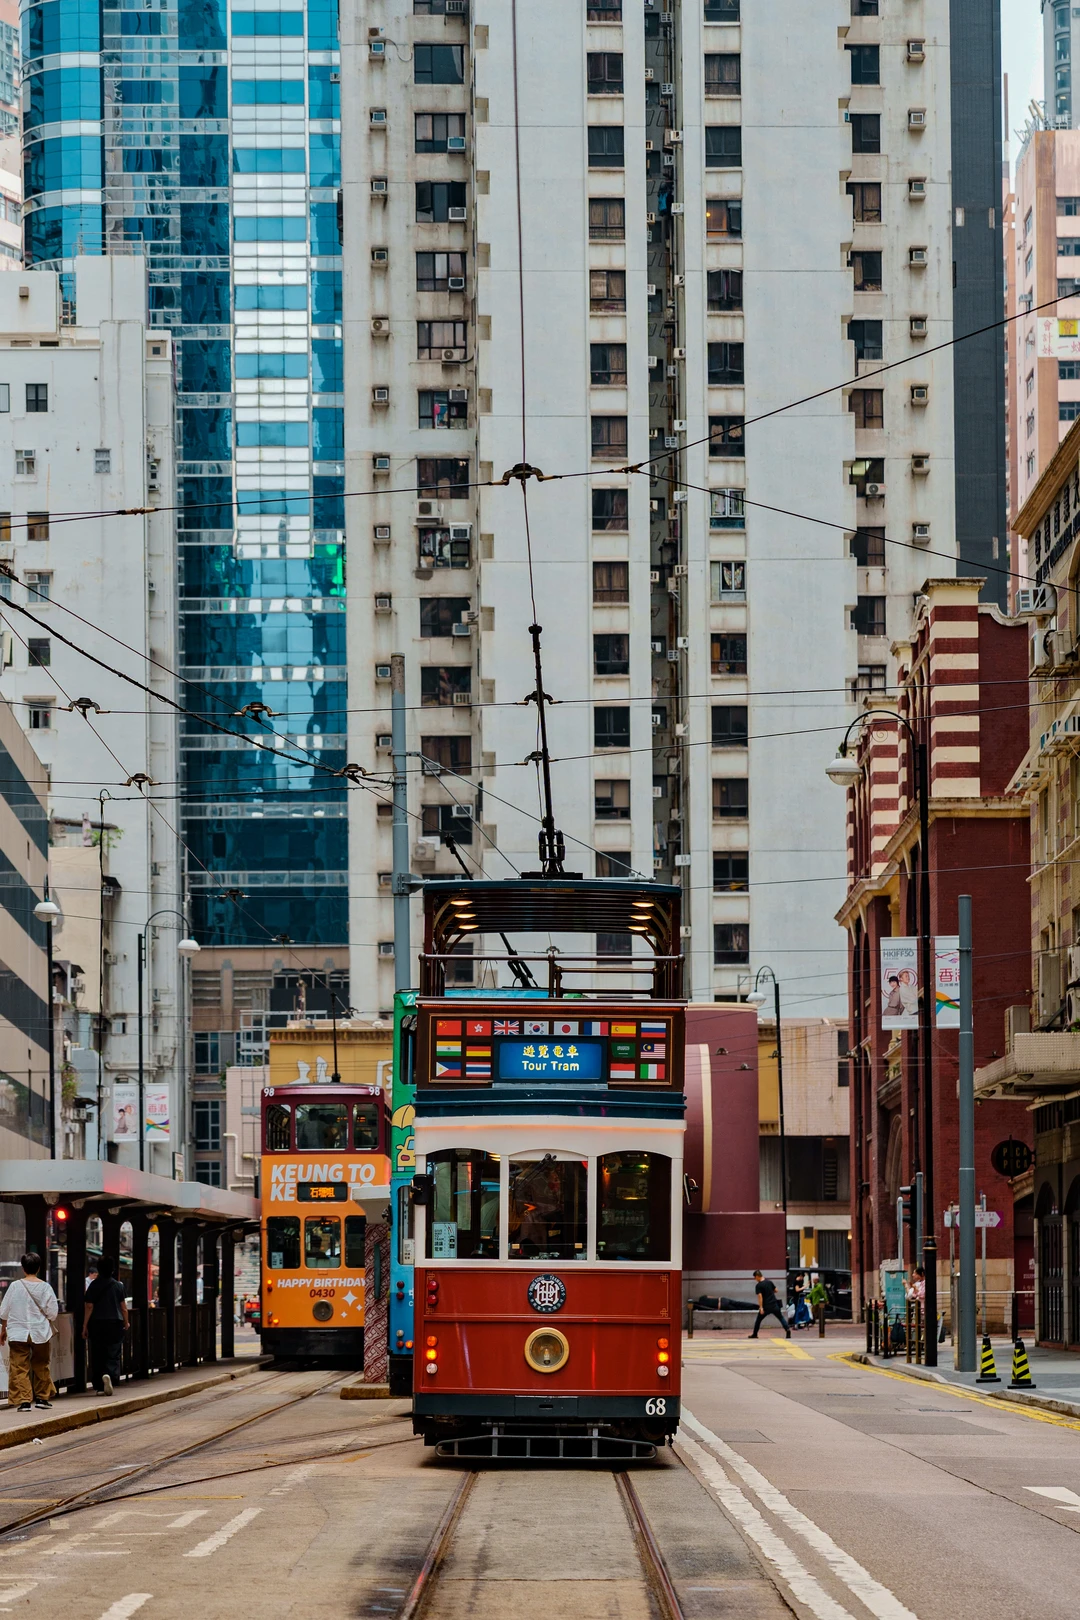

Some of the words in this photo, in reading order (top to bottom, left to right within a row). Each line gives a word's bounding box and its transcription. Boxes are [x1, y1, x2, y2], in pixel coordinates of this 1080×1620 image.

[522, 1044, 579, 1058] 遊覽電車
[521, 1060, 547, 1071] Tour
[550, 1060, 580, 1071] Tram
[263, 1087, 275, 1097] 98
[368, 1086, 380, 1096] 98
[271, 1164, 343, 1183] KEUNG
[347, 1164, 376, 1183] TO
[277, 1278, 312, 1288] HAPPY
[313, 1278, 366, 1288] BIRTHDAY
[309, 1289, 335, 1298] 0430
[645, 1398, 666, 1415] 68
